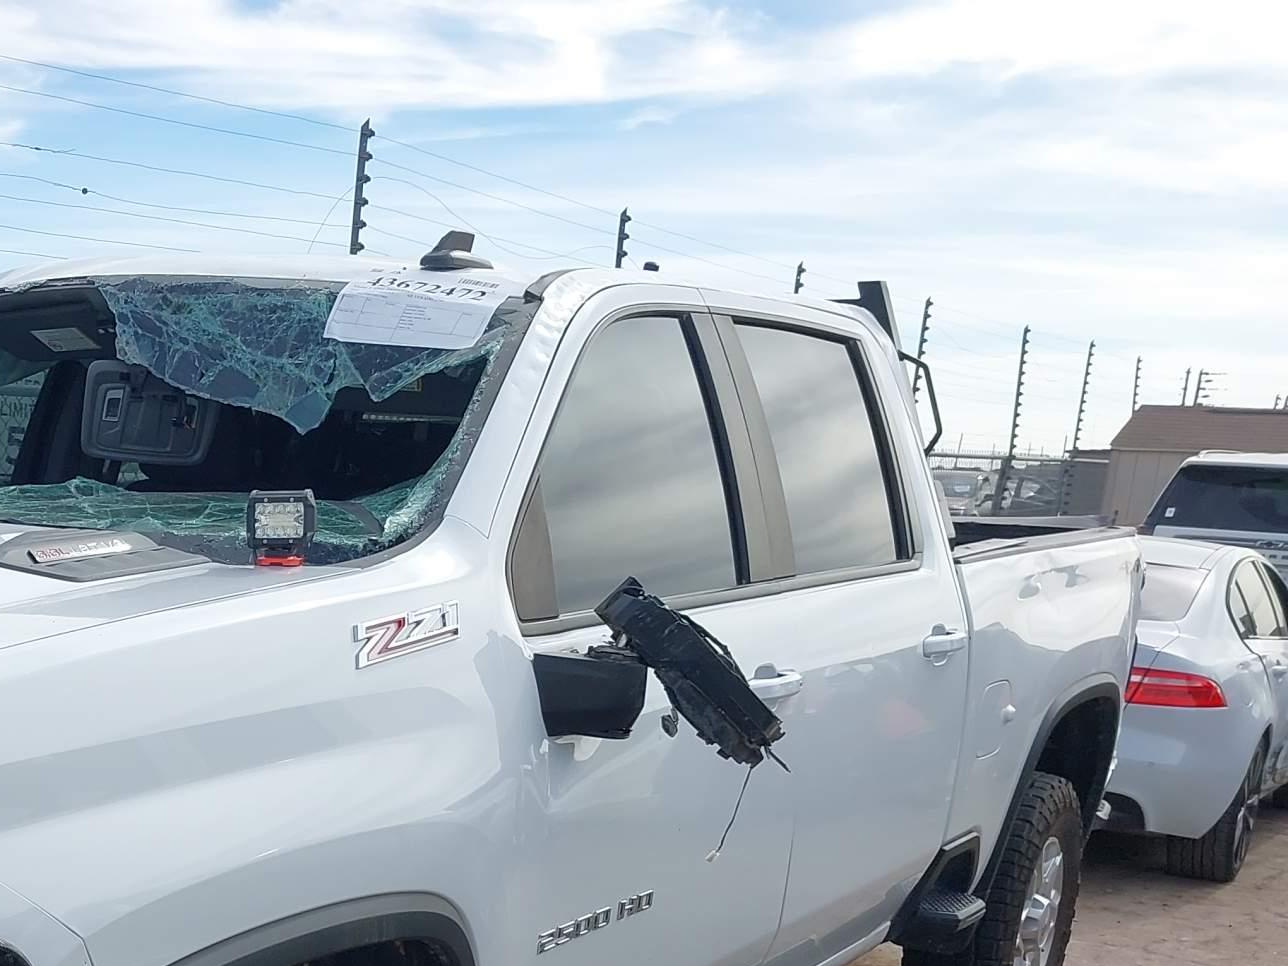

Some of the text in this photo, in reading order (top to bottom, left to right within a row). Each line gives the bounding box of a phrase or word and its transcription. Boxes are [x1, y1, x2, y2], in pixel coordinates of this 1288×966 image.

[366, 276, 487, 302] 43672472
[353, 601, 459, 670] Z71
[537, 889, 654, 955] 2500 HD
